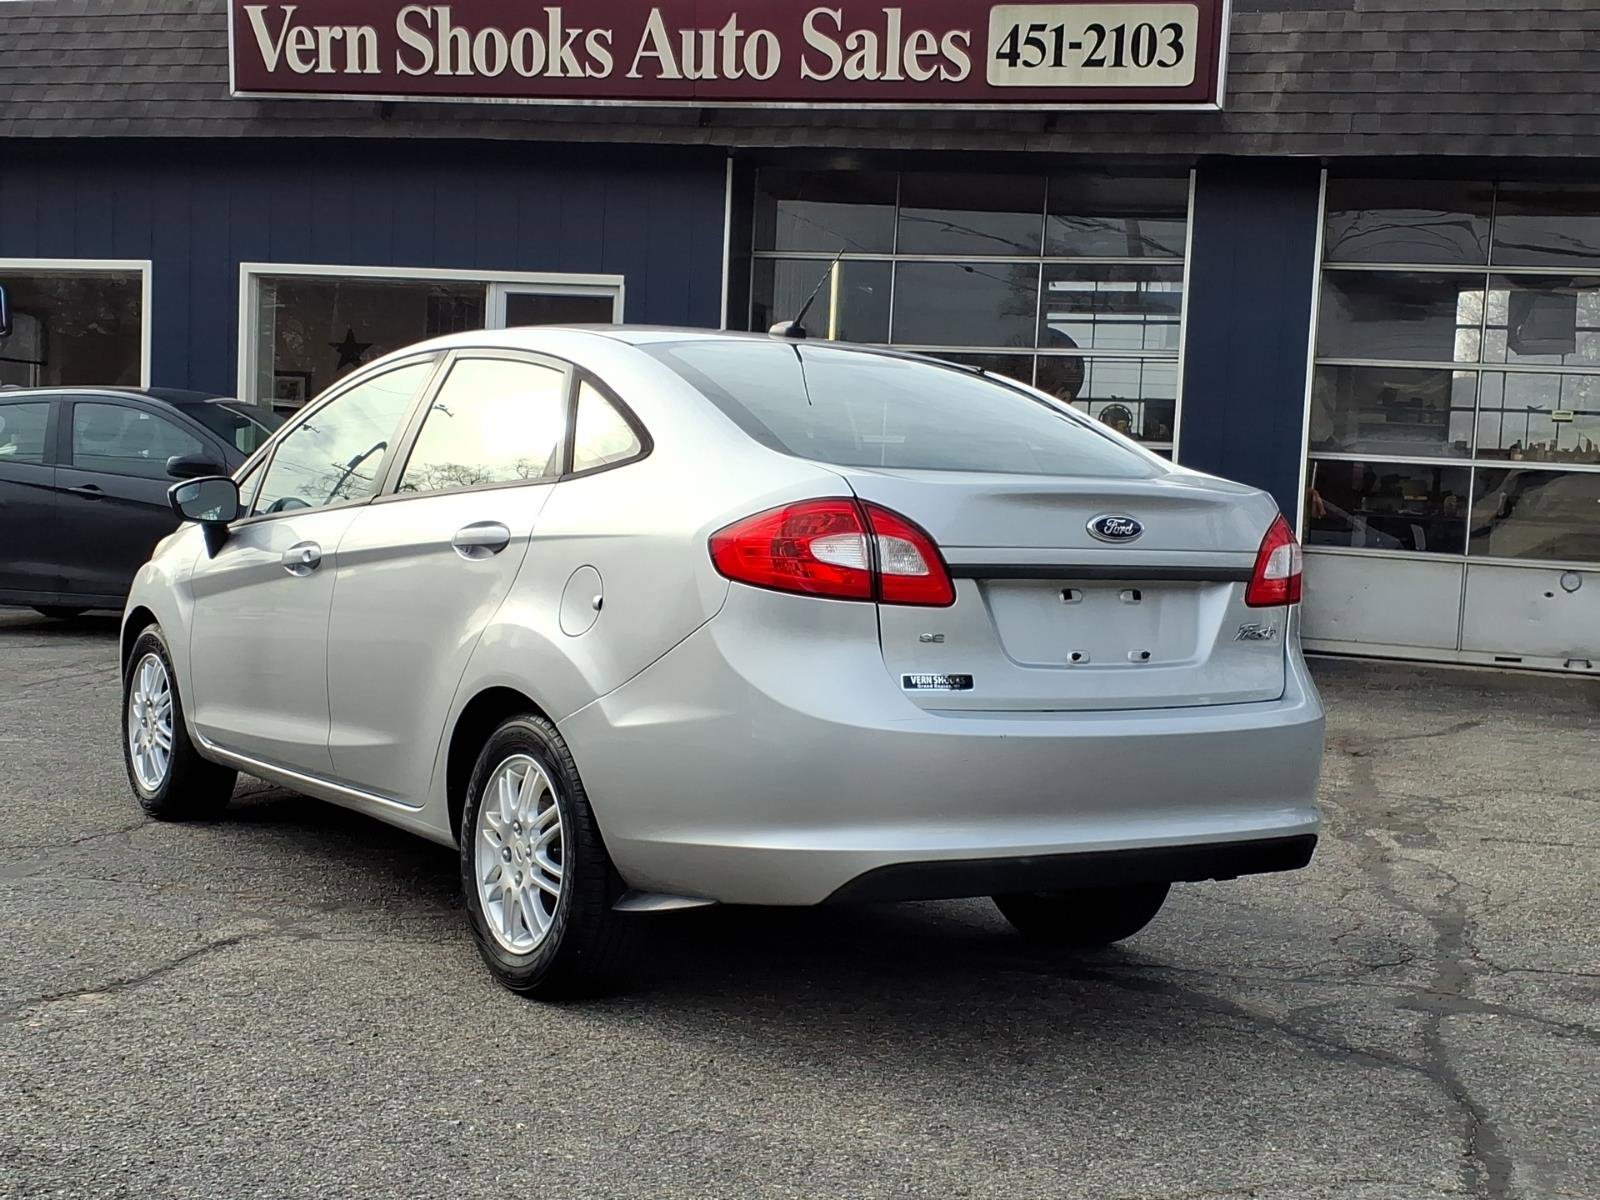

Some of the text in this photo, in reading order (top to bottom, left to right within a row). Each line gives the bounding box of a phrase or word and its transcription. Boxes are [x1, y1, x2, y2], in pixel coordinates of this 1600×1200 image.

[244, 4, 1185, 83] Vern Shooks Auto Sales 451-2103
[1103, 518, 1134, 534] Ford
[919, 633, 944, 643] SE
[910, 676, 932, 685] VERN
